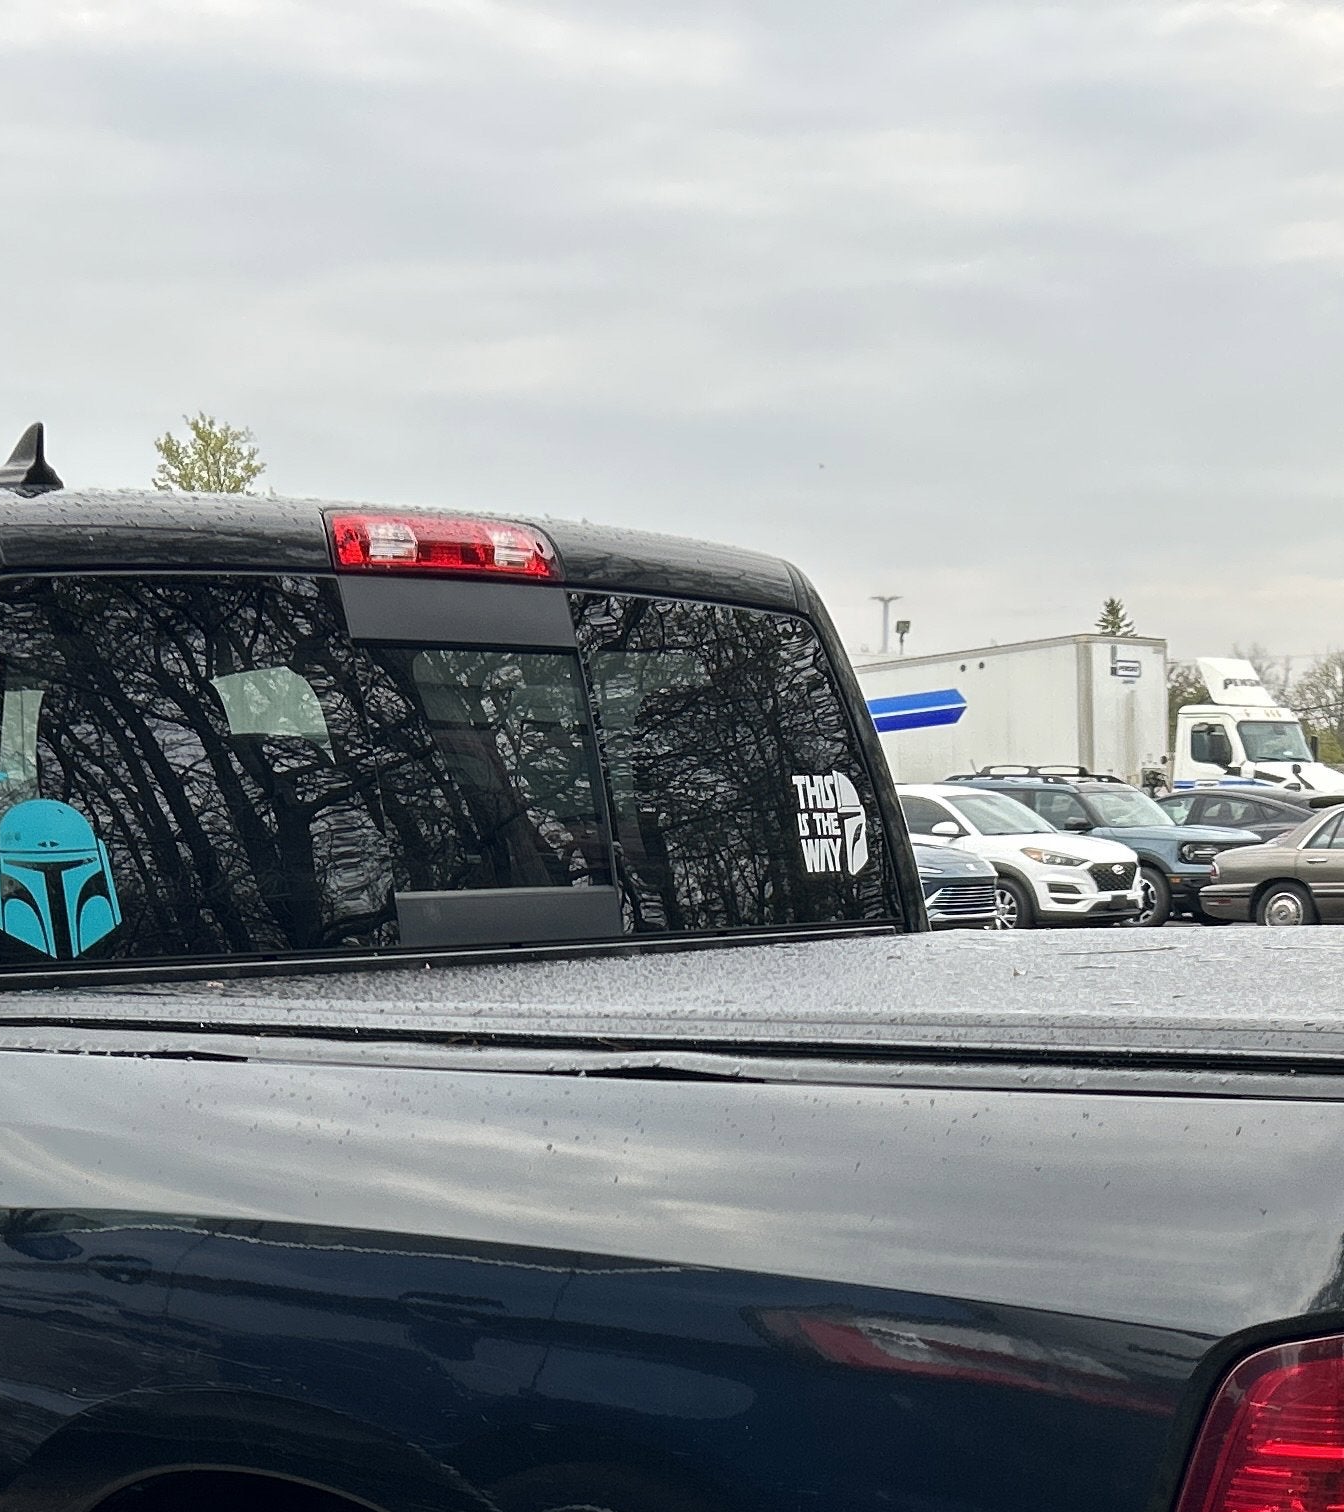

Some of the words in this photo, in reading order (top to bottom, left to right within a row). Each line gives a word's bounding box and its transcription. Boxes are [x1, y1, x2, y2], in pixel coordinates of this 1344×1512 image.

[792, 775, 836, 809] THIS
[797, 813, 809, 836] IS
[813, 813, 841, 836] THE
[801, 838, 841, 872] WAY
